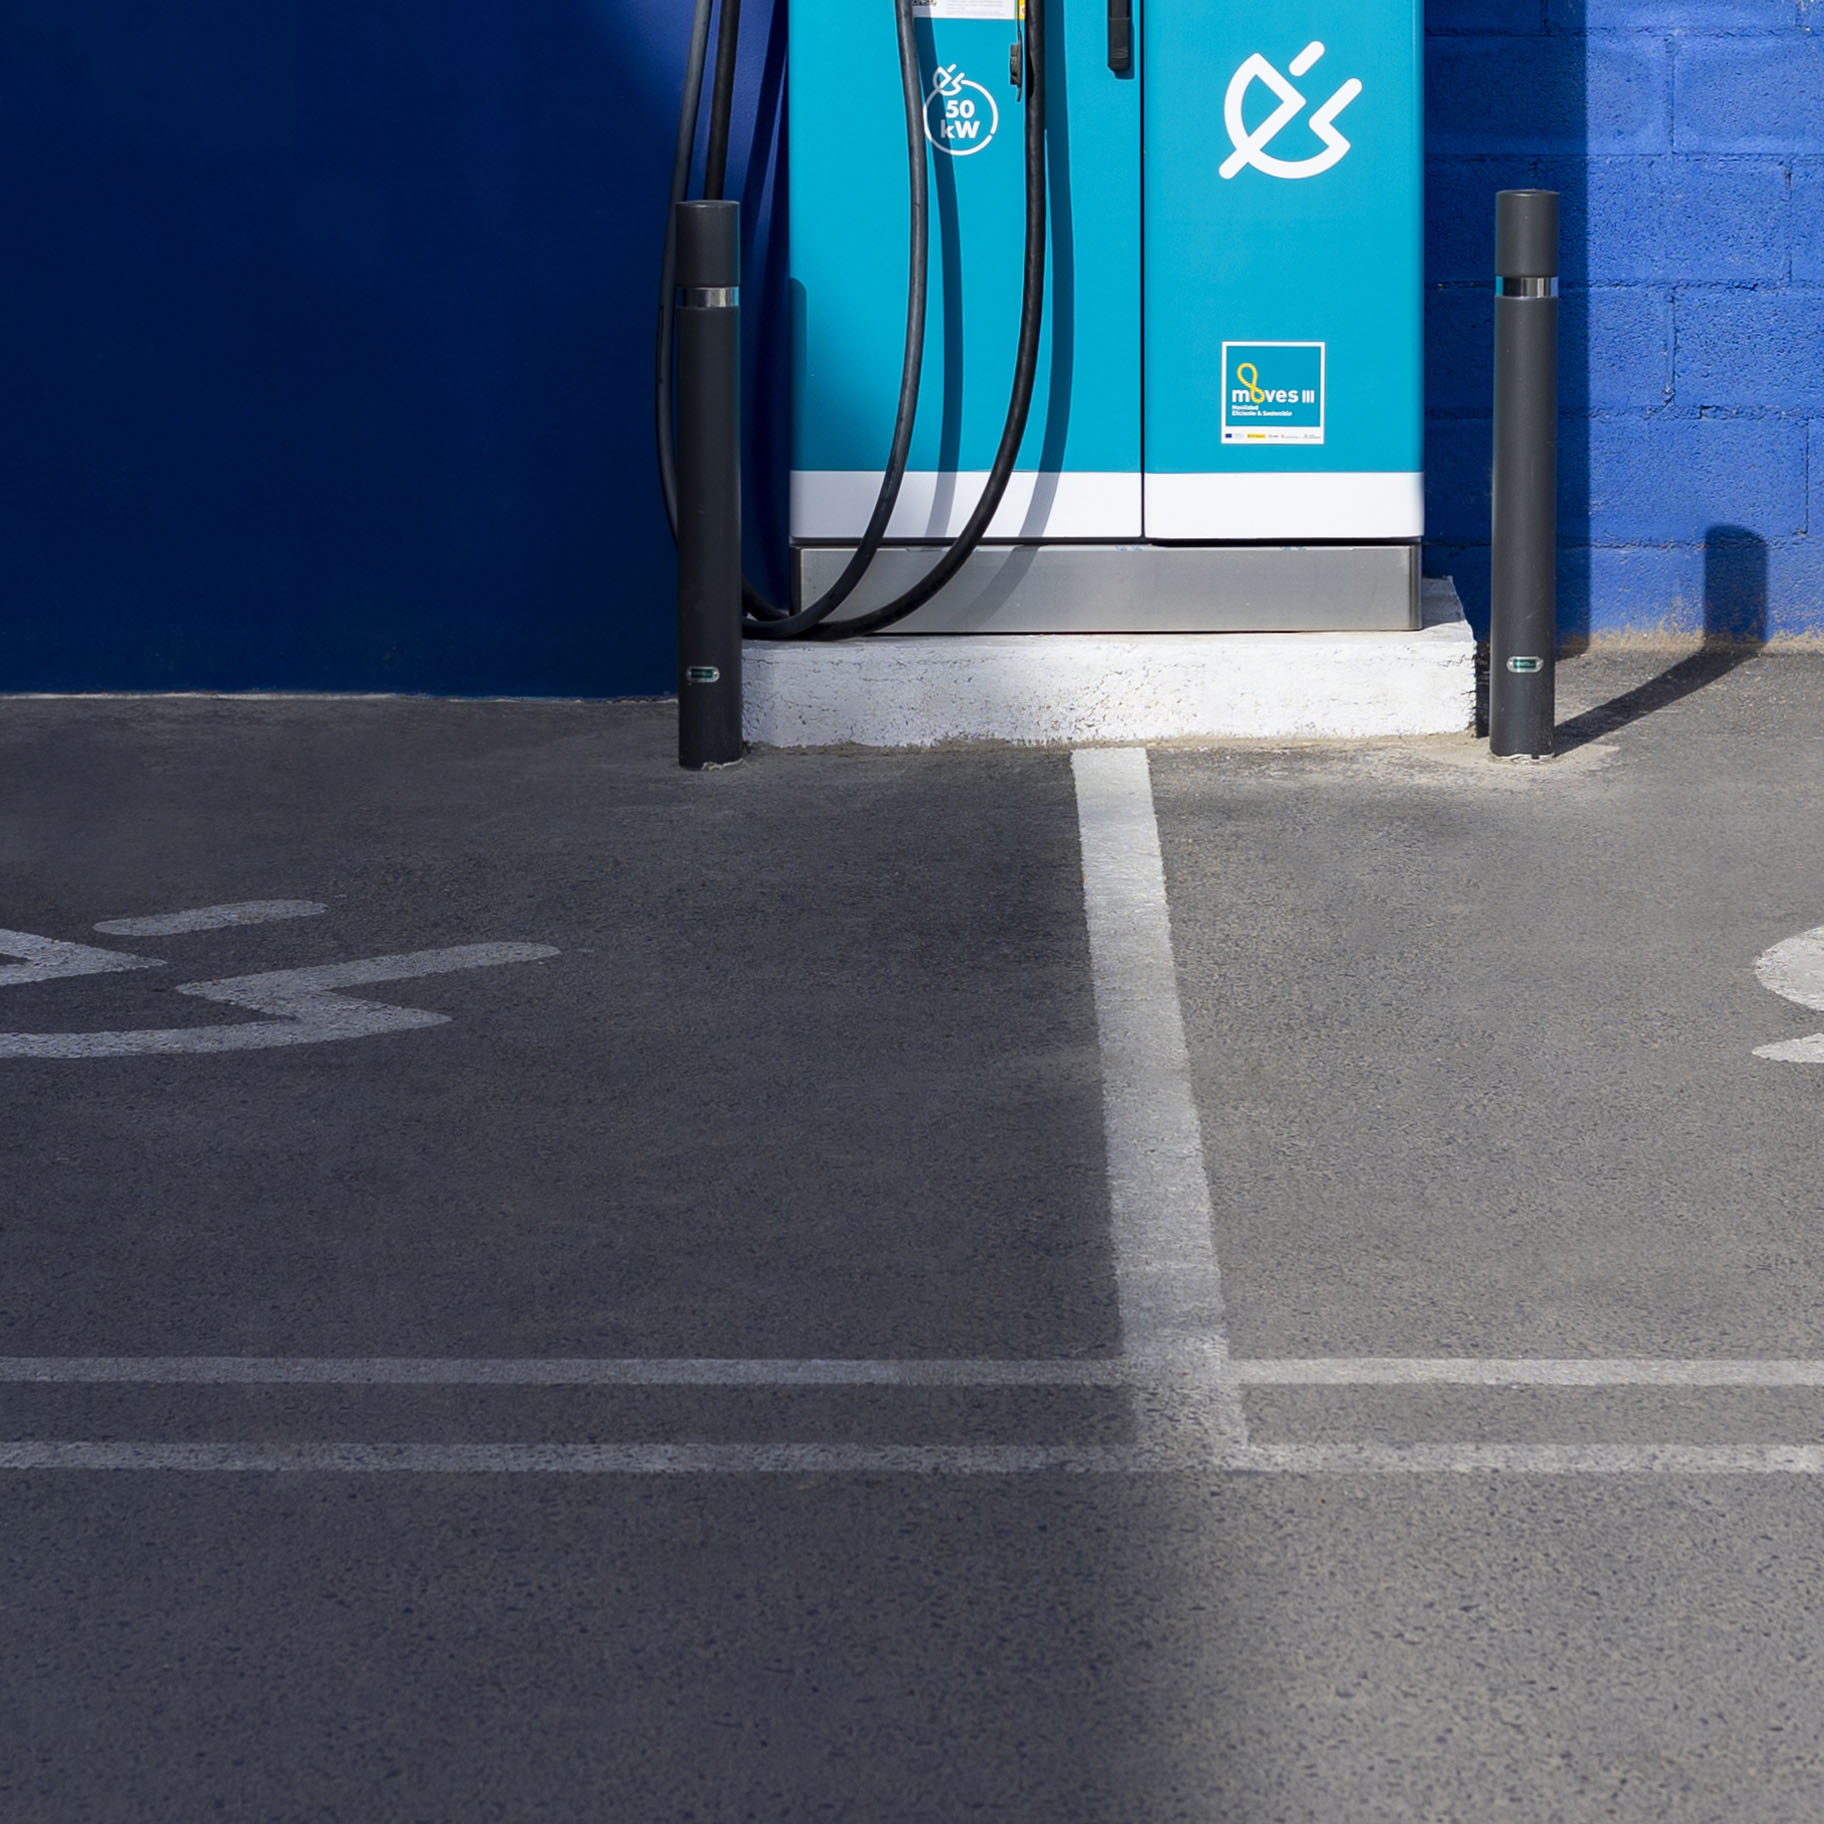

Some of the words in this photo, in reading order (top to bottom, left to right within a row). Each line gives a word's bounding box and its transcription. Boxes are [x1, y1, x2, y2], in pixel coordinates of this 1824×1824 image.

[945, 99, 975, 119] 50
[940, 120, 980, 139] kW
[1232, 388, 1299, 404] moves
[1302, 389, 1315, 404] III
